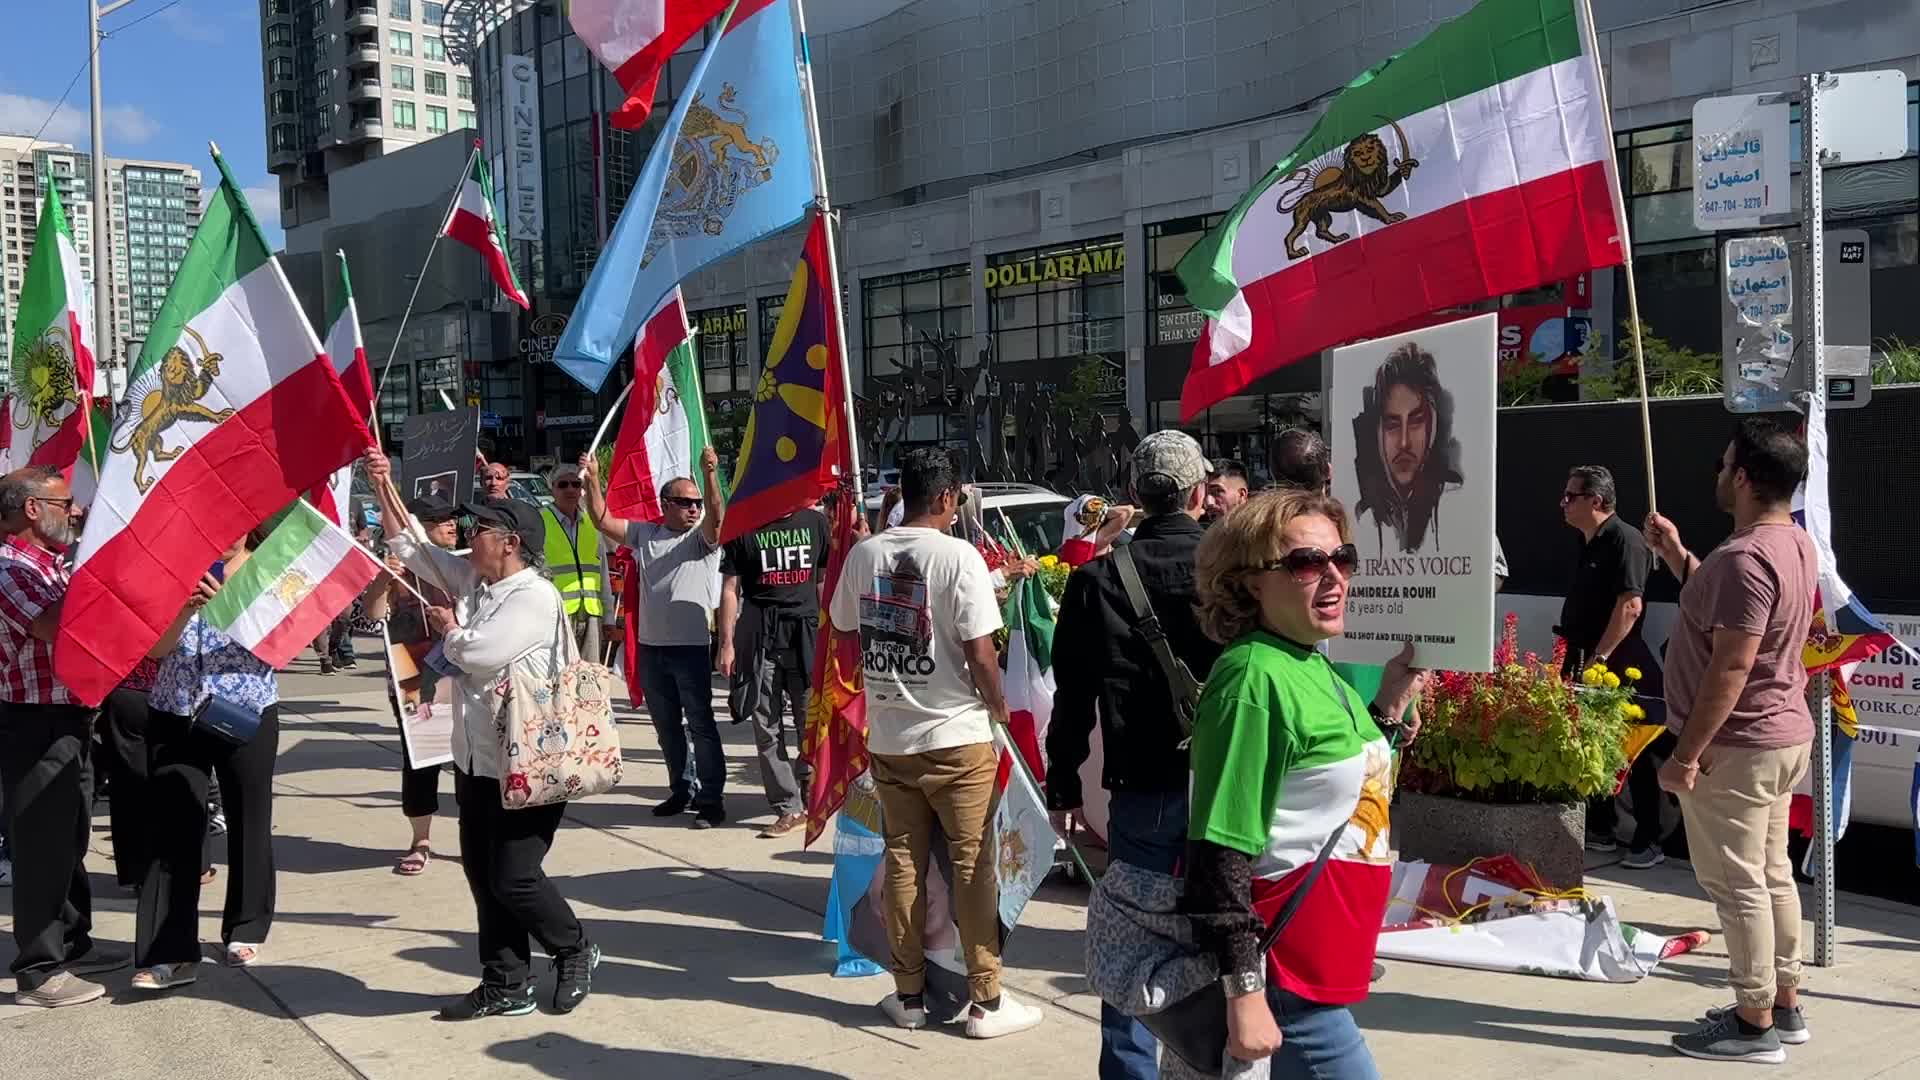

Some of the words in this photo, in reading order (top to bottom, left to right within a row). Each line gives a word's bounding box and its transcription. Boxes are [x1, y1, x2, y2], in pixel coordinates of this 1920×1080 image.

[511, 63, 537, 236] CINEPLEX
[1705, 169, 1760, 190] اصفهان
[984, 247, 1126, 288] DOLLARAMA
[1160, 294, 1174, 305] NO
[1160, 311, 1204, 327] SWEETER
[1160, 329, 1183, 341] THAN
[519, 336, 560, 352] CINEP
[528, 352, 554, 363] CINE
[756, 528, 811, 549] WOMAN
[761, 545, 812, 573] LIFE
[1365, 558, 1415, 577] IRAN'S
[1419, 556, 1472, 576] VOICE
[1403, 587, 1436, 598] ROUHI
[1358, 603, 1384, 616] years
[1387, 602, 1403, 614] old
[1358, 632, 1375, 640] SHOT
[1376, 632, 1390, 641] AND
[1900, 623, 1920, 636] WI
[882, 643, 905, 654] FORD
[864, 651, 936, 676] RONCO
[1851, 672, 1904, 689] cond
[1856, 729, 1900, 747] 901
